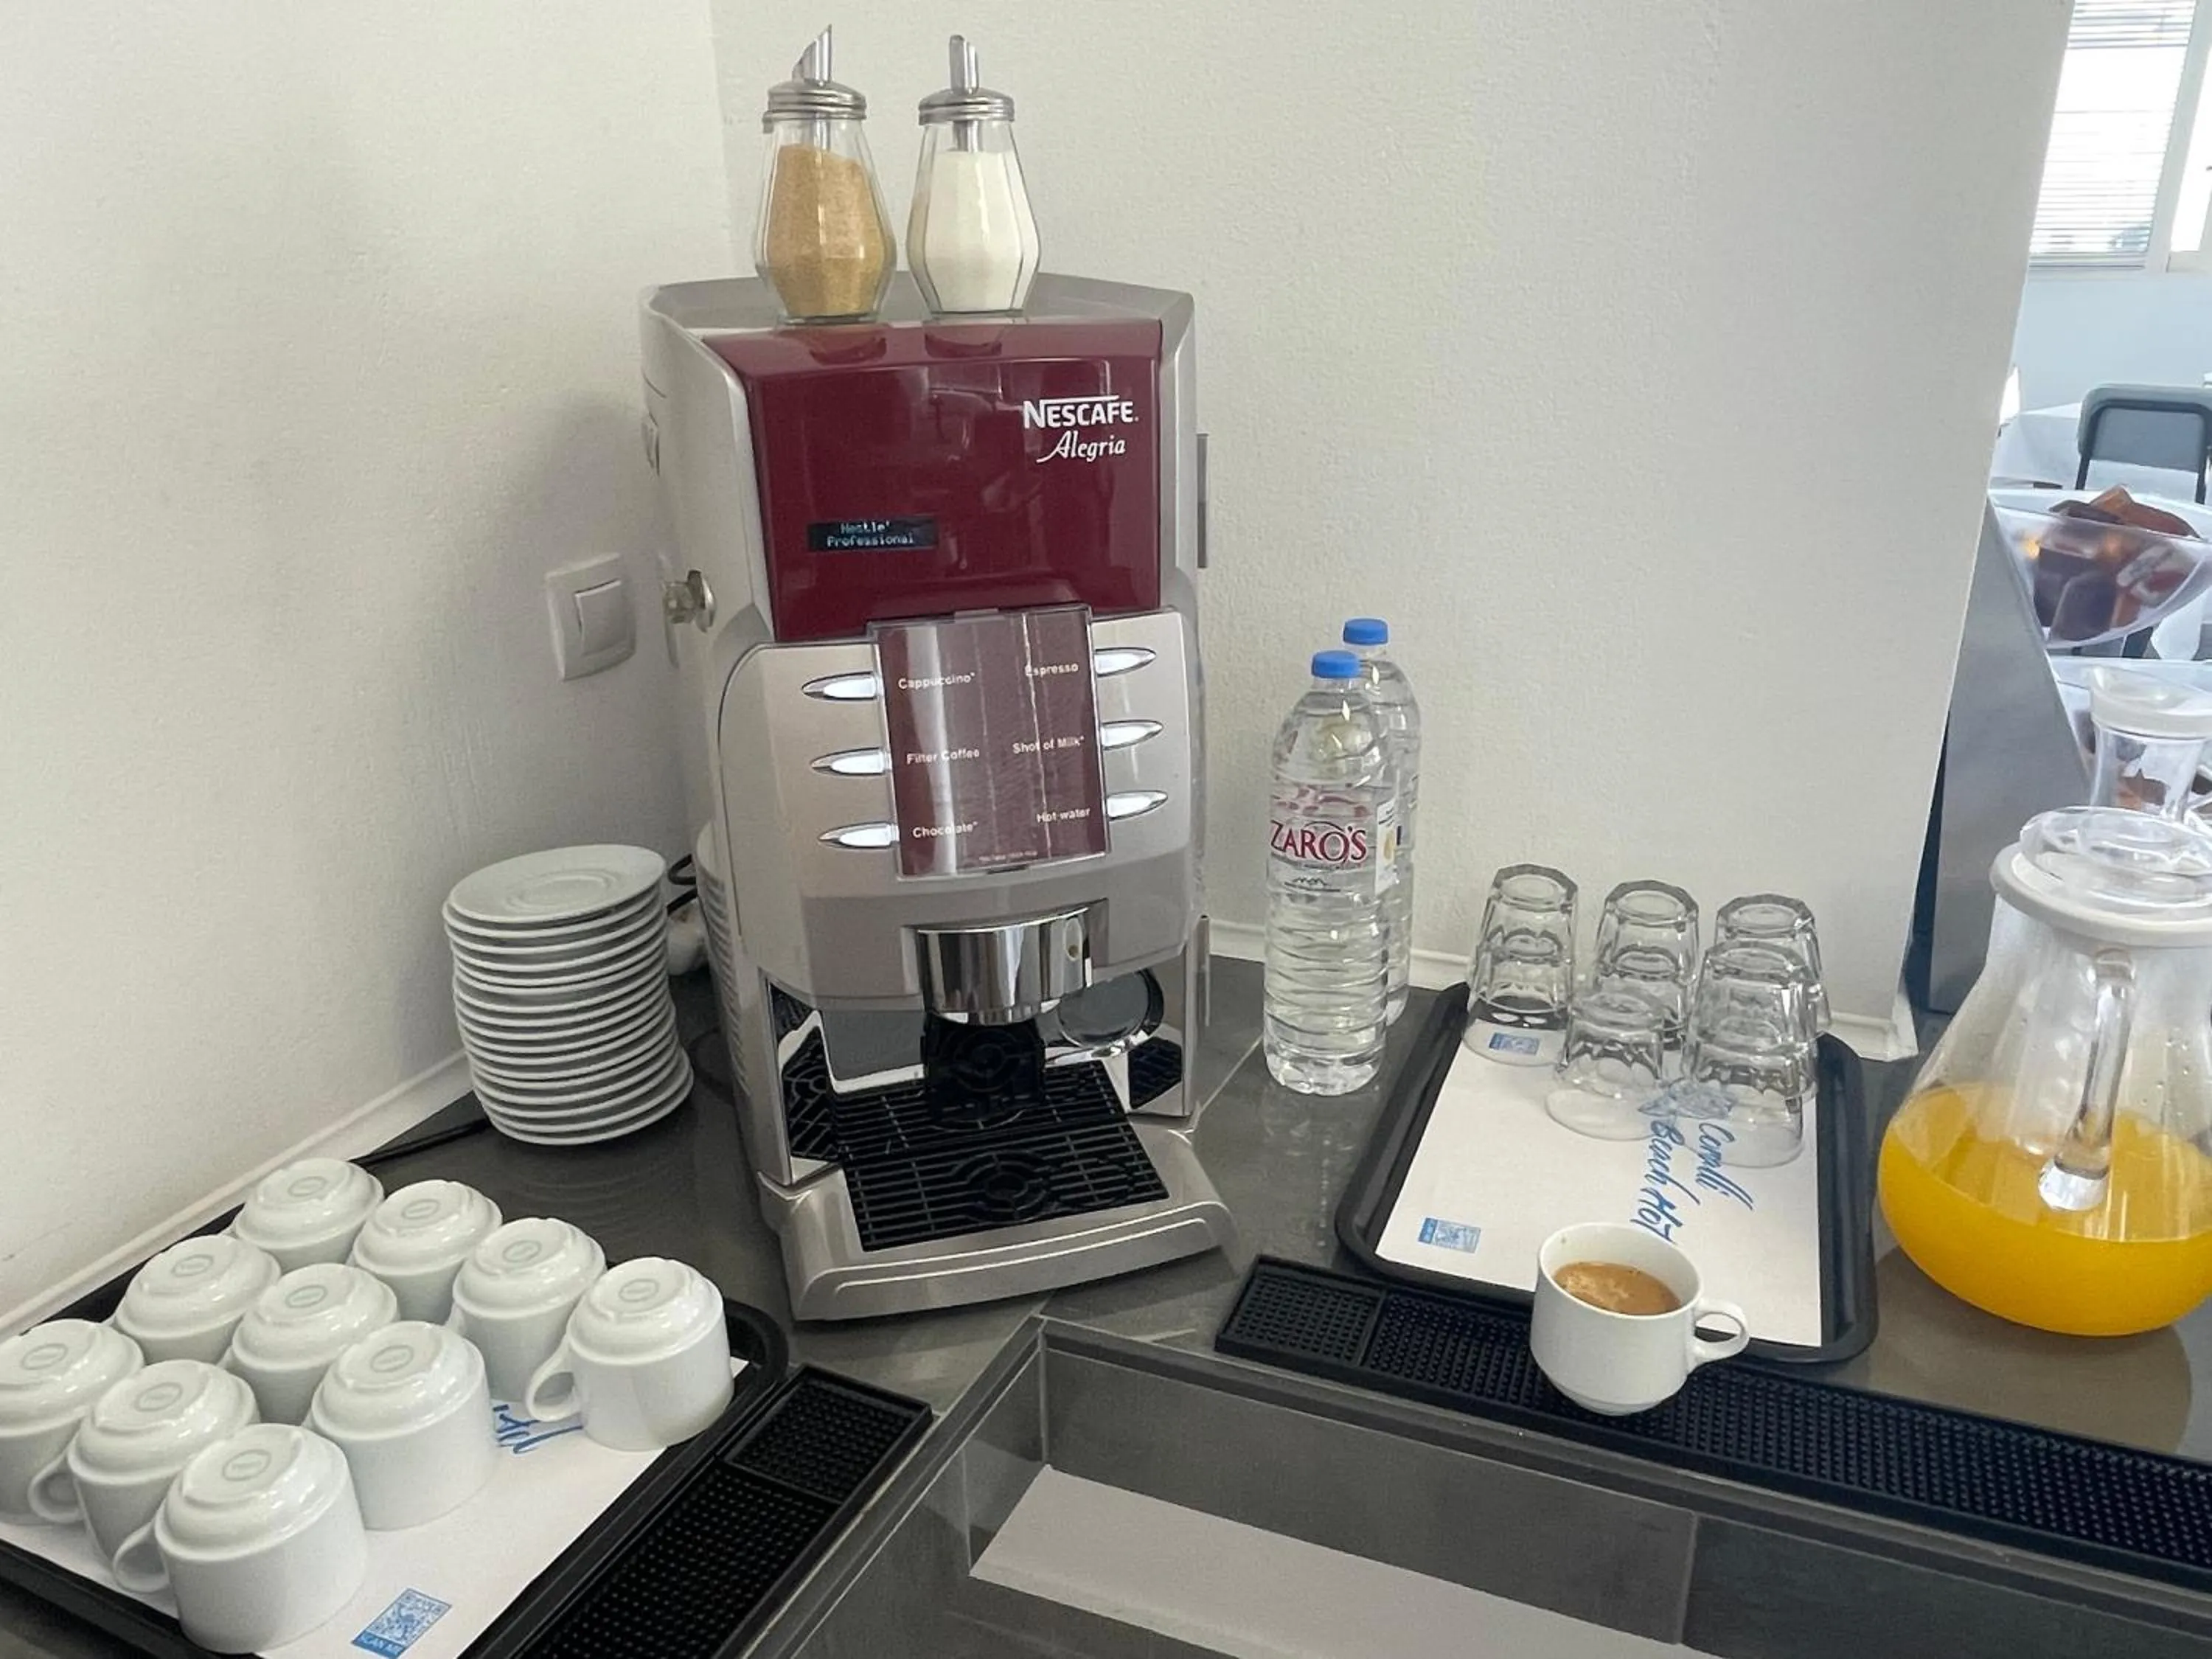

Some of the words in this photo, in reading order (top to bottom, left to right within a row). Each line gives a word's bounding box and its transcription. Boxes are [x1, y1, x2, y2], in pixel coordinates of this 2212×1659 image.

[1036, 430, 1127, 463] Alegria
[826, 532, 914, 548] Professional
[1025, 662, 1079, 677] Espresso
[1012, 741, 1040, 754] Shot
[1043, 740, 1055, 751] of
[906, 752, 937, 765] Filter
[940, 748, 981, 762] Coffee
[1037, 813, 1057, 824] Hot
[1060, 807, 1091, 820] water
[1630, 1188, 1683, 1245] Hot
